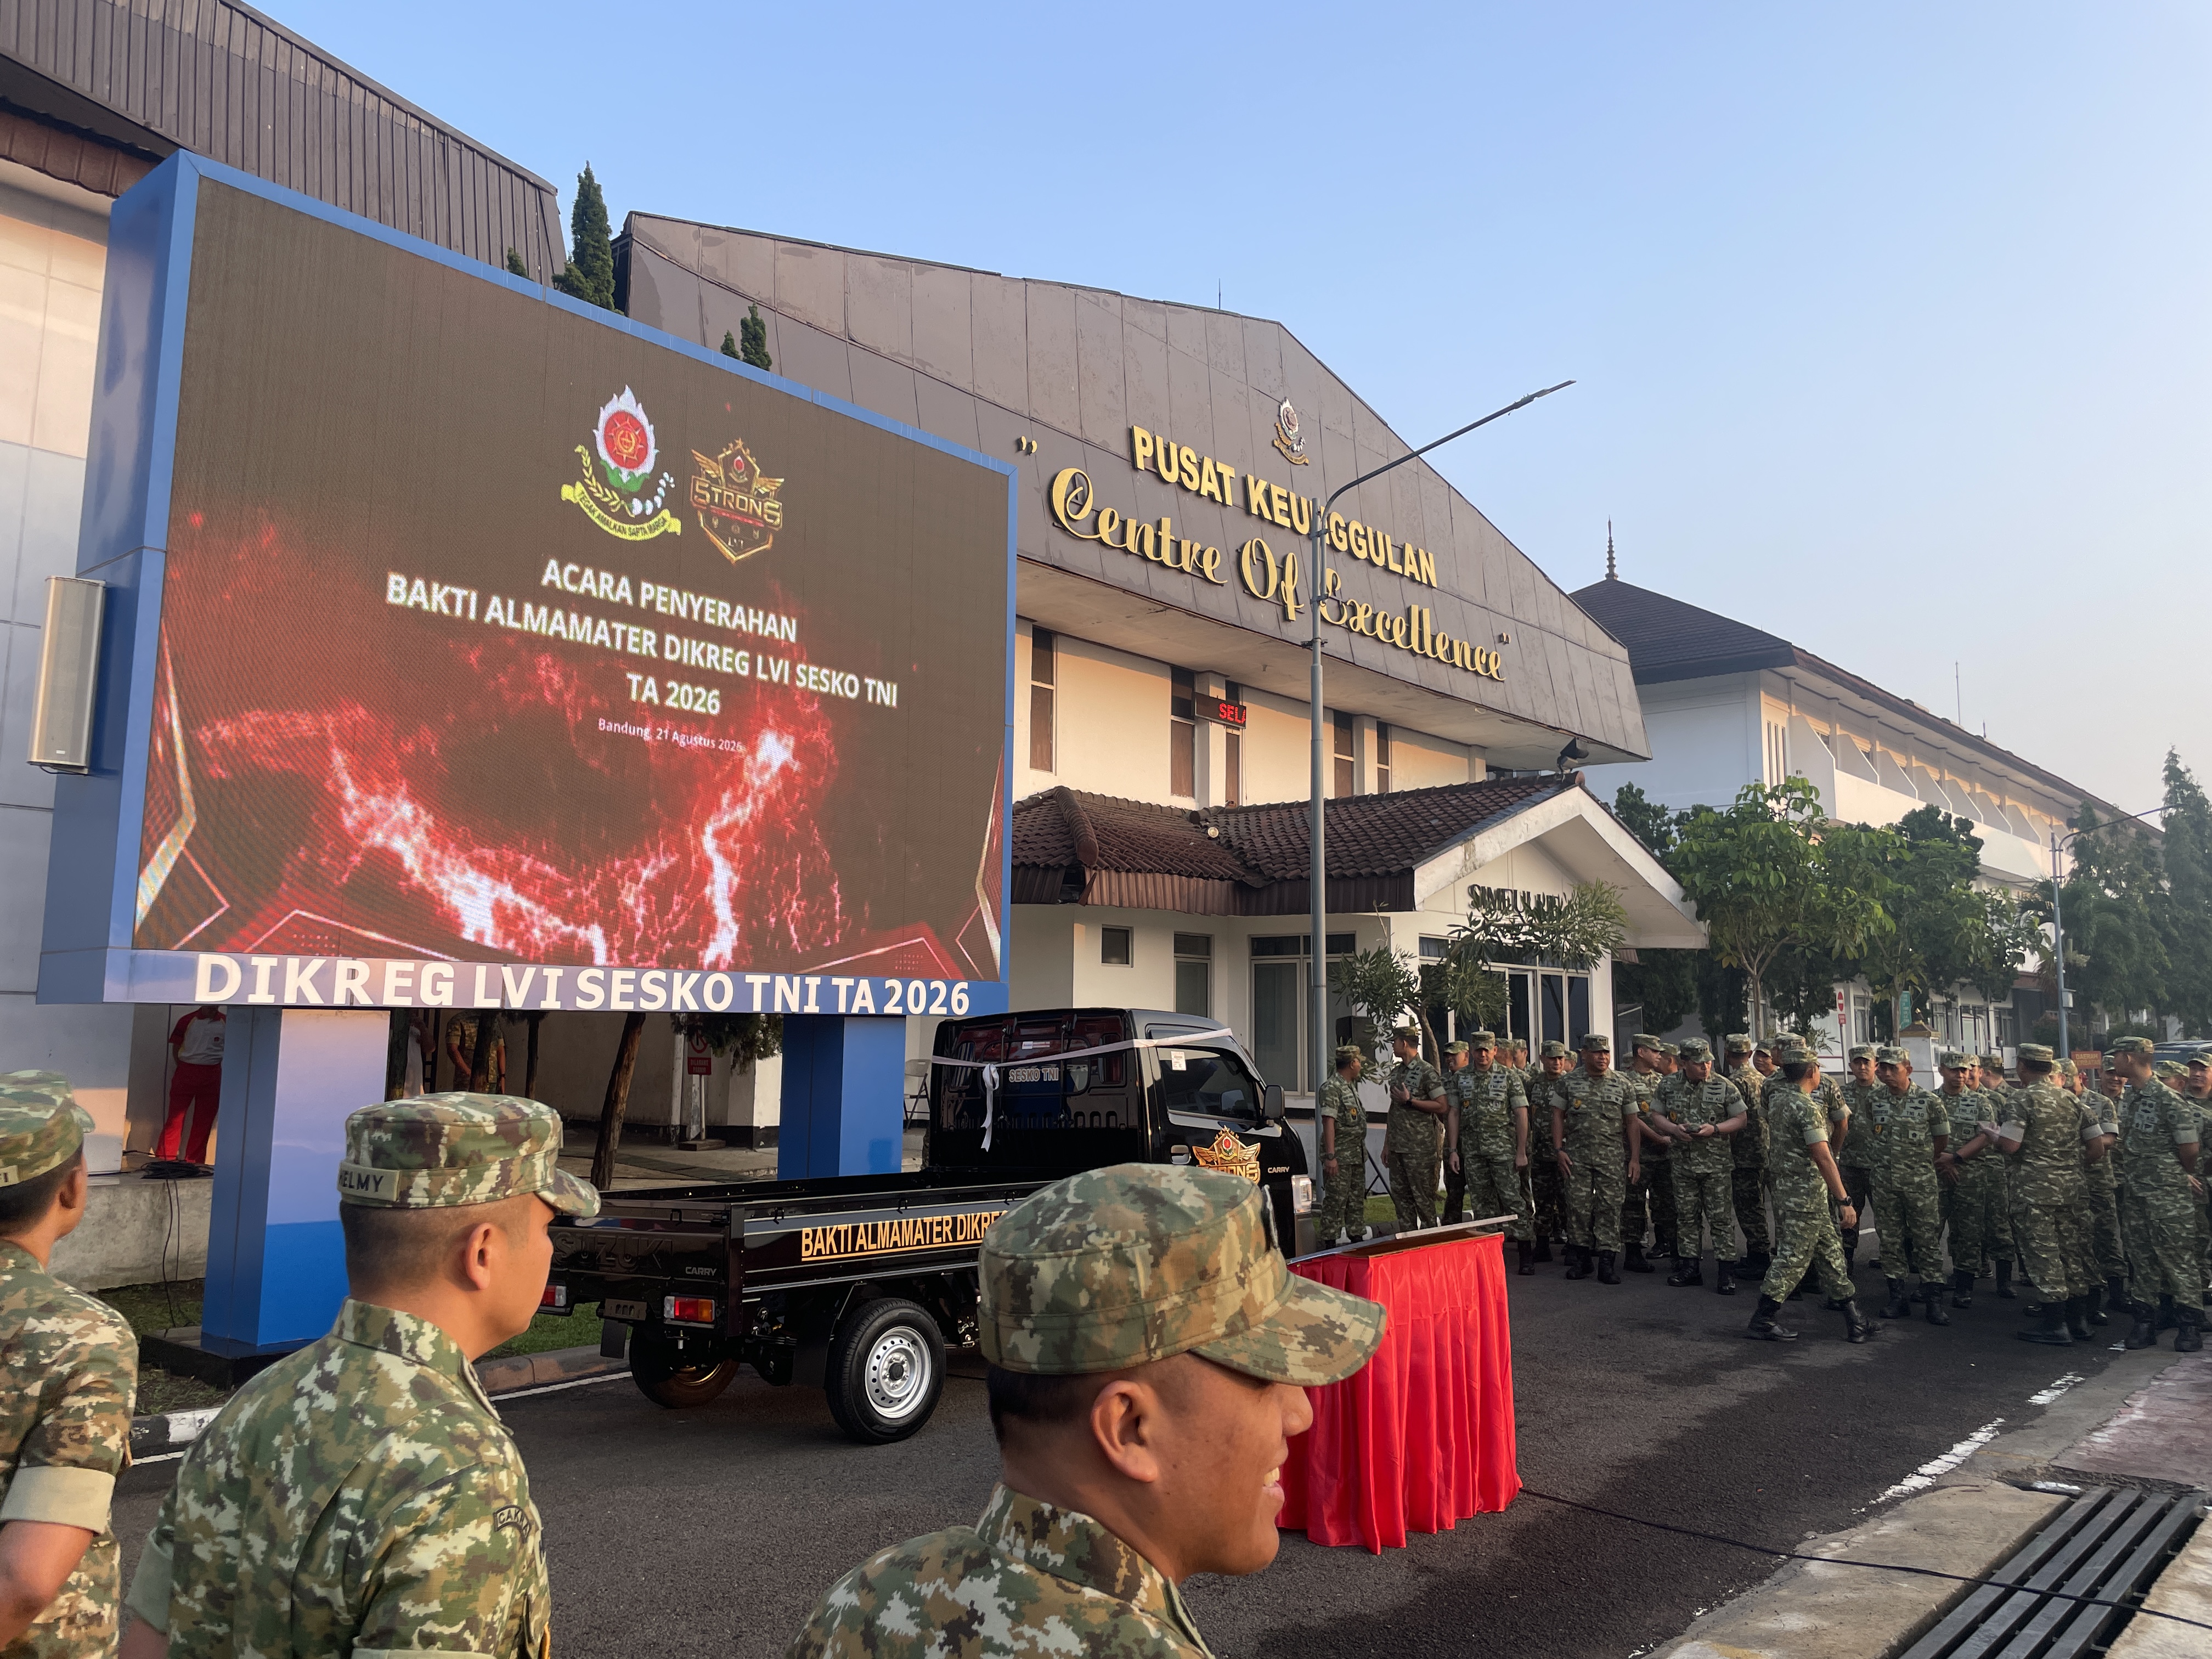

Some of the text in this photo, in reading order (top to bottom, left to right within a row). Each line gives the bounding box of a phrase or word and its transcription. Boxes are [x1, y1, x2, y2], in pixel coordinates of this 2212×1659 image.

[1131, 425, 1235, 507] PUSAT
[1051, 467, 1228, 585] Centre
[1240, 538, 1304, 621] Of
[541, 558, 798, 643] ACARA PENYERAHAN
[386, 572, 898, 708] BAKTI ALMAMATER DIKREG LVI SESKO TNI
[626, 672, 721, 715] TA 2026
[656, 727, 669, 741] 21
[672, 731, 716, 748] Agustus
[718, 738, 744, 752] 2026
[194, 953, 970, 1015] DIKREG LVI SESKO TNI TA 2026
[1009, 1068, 1059, 1082] SESKO TNI
[802, 1223, 852, 1257] BAKTI
[855, 1215, 953, 1251] ALMAMATER
[686, 1266, 716, 1277] CARRY
